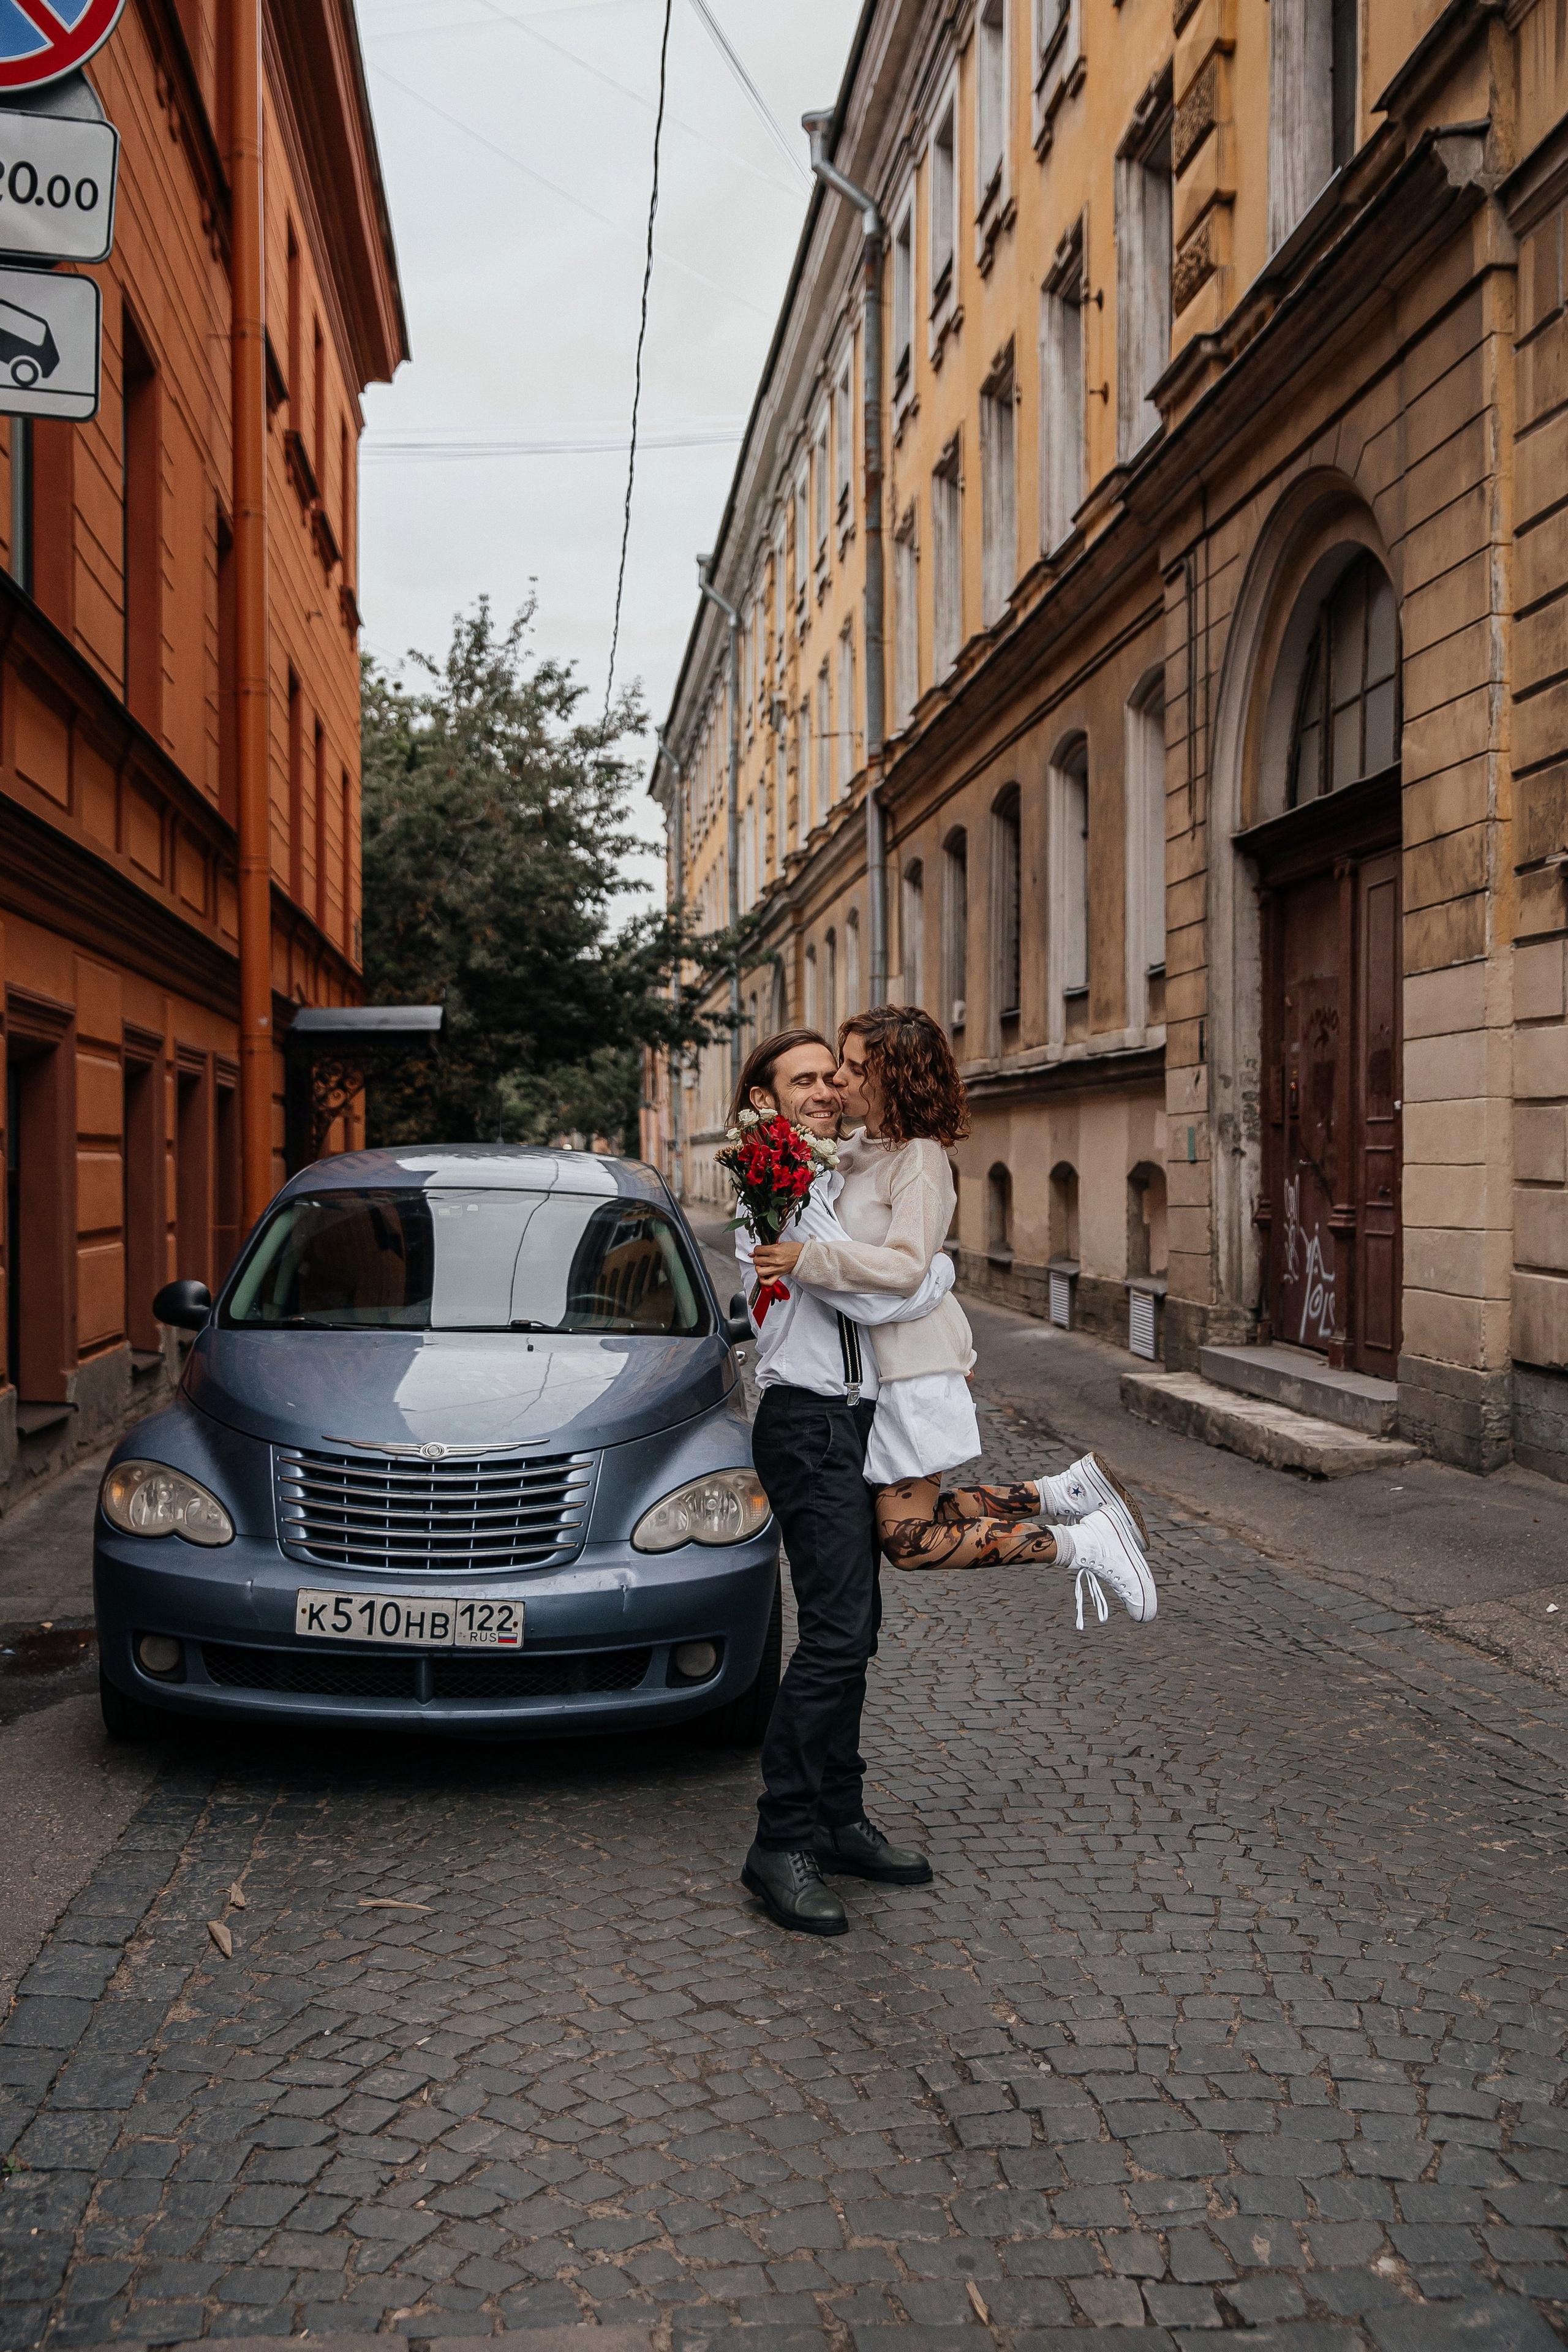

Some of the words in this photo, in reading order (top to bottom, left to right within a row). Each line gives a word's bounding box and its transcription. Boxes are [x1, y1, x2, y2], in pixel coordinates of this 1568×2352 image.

[0, 160, 99, 211] 0.00
[307, 1597, 450, 1639] К510НВ
[459, 1603, 514, 1632] 122
[470, 1631, 497, 1643] RUS
